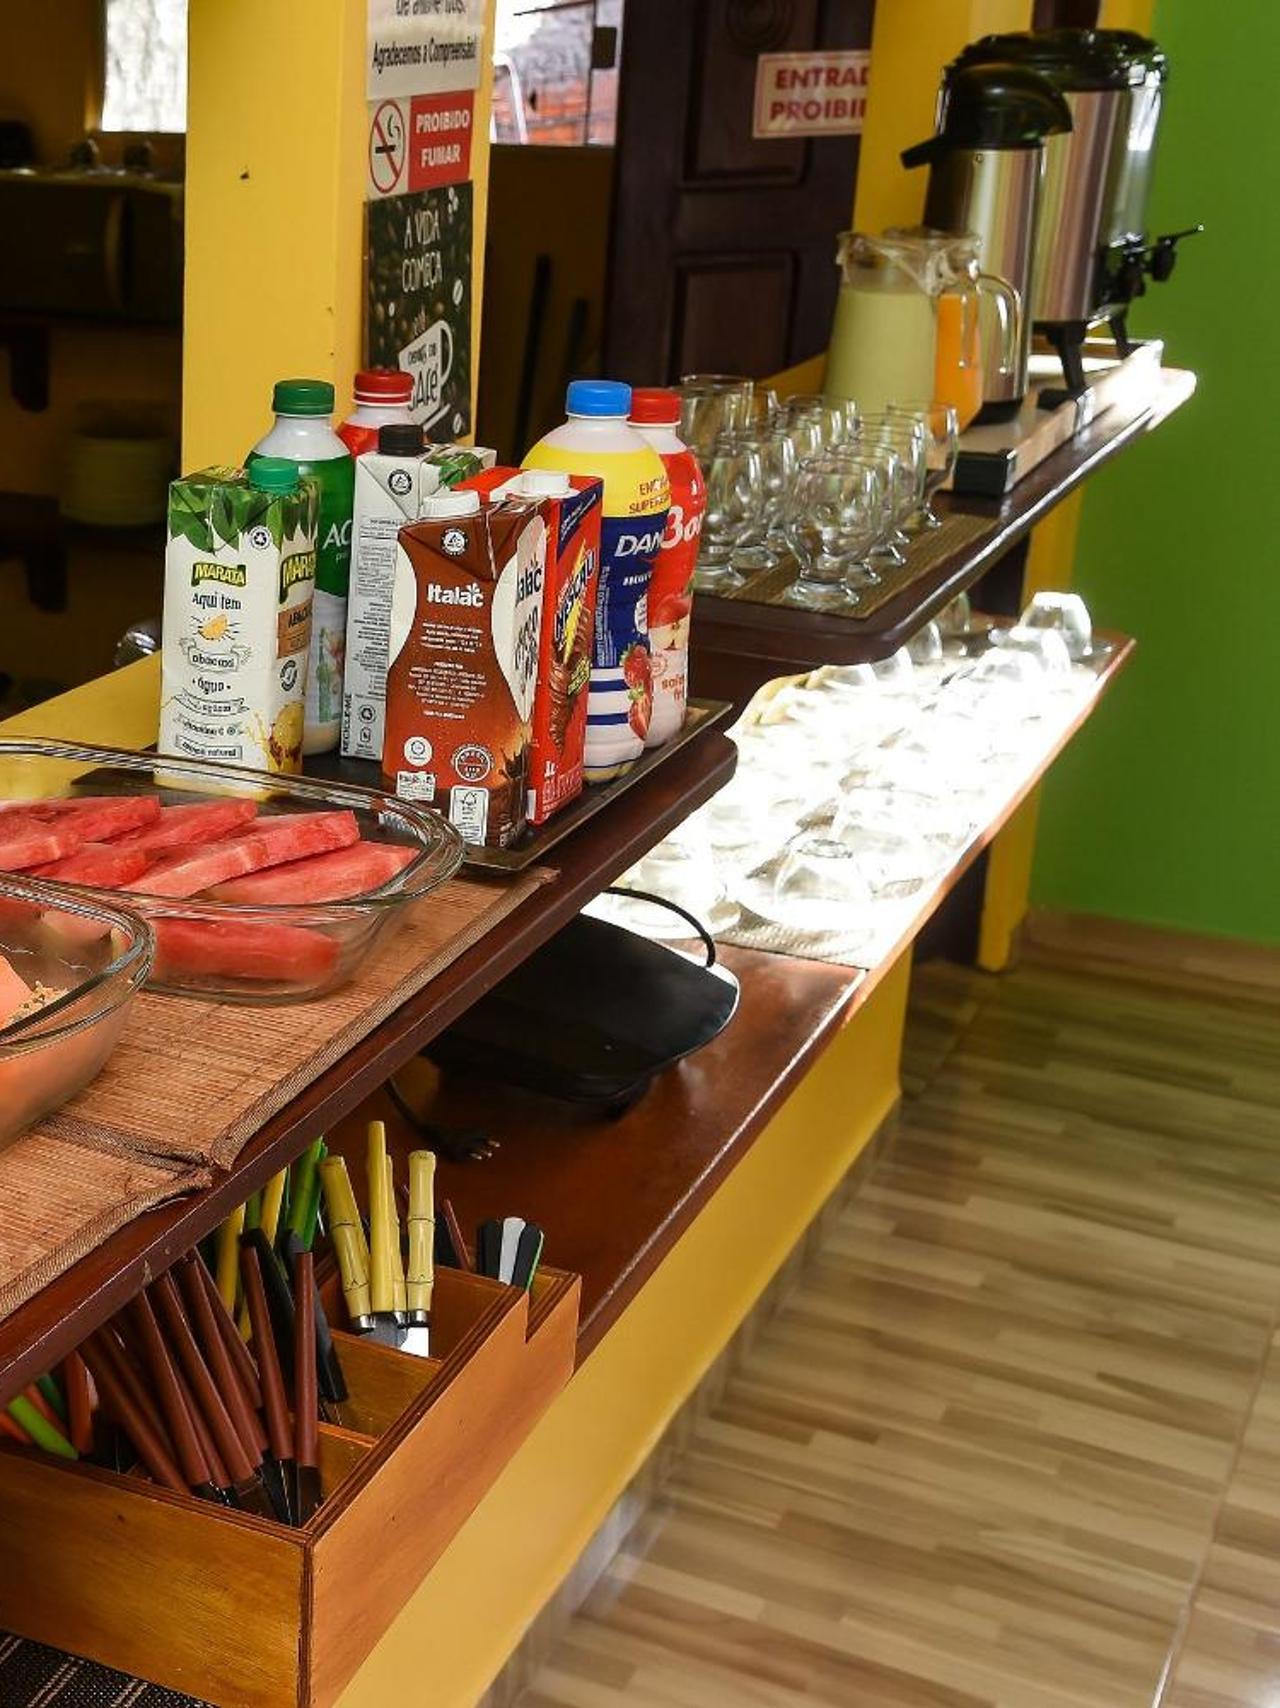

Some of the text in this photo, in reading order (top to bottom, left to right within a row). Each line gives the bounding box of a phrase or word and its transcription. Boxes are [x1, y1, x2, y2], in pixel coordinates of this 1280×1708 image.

[372, 40, 421, 74] Agradecemos
[422, 45, 428, 63] a
[415, 109, 471, 134] PROIBIDO
[770, 98, 867, 121] PROIBI
[421, 144, 461, 168] FUMAR
[404, 209, 441, 249] A VIDA
[402, 250, 442, 292] COMEÇA
[192, 591, 242, 610] Aqui tem
[426, 582, 484, 608] Italac
